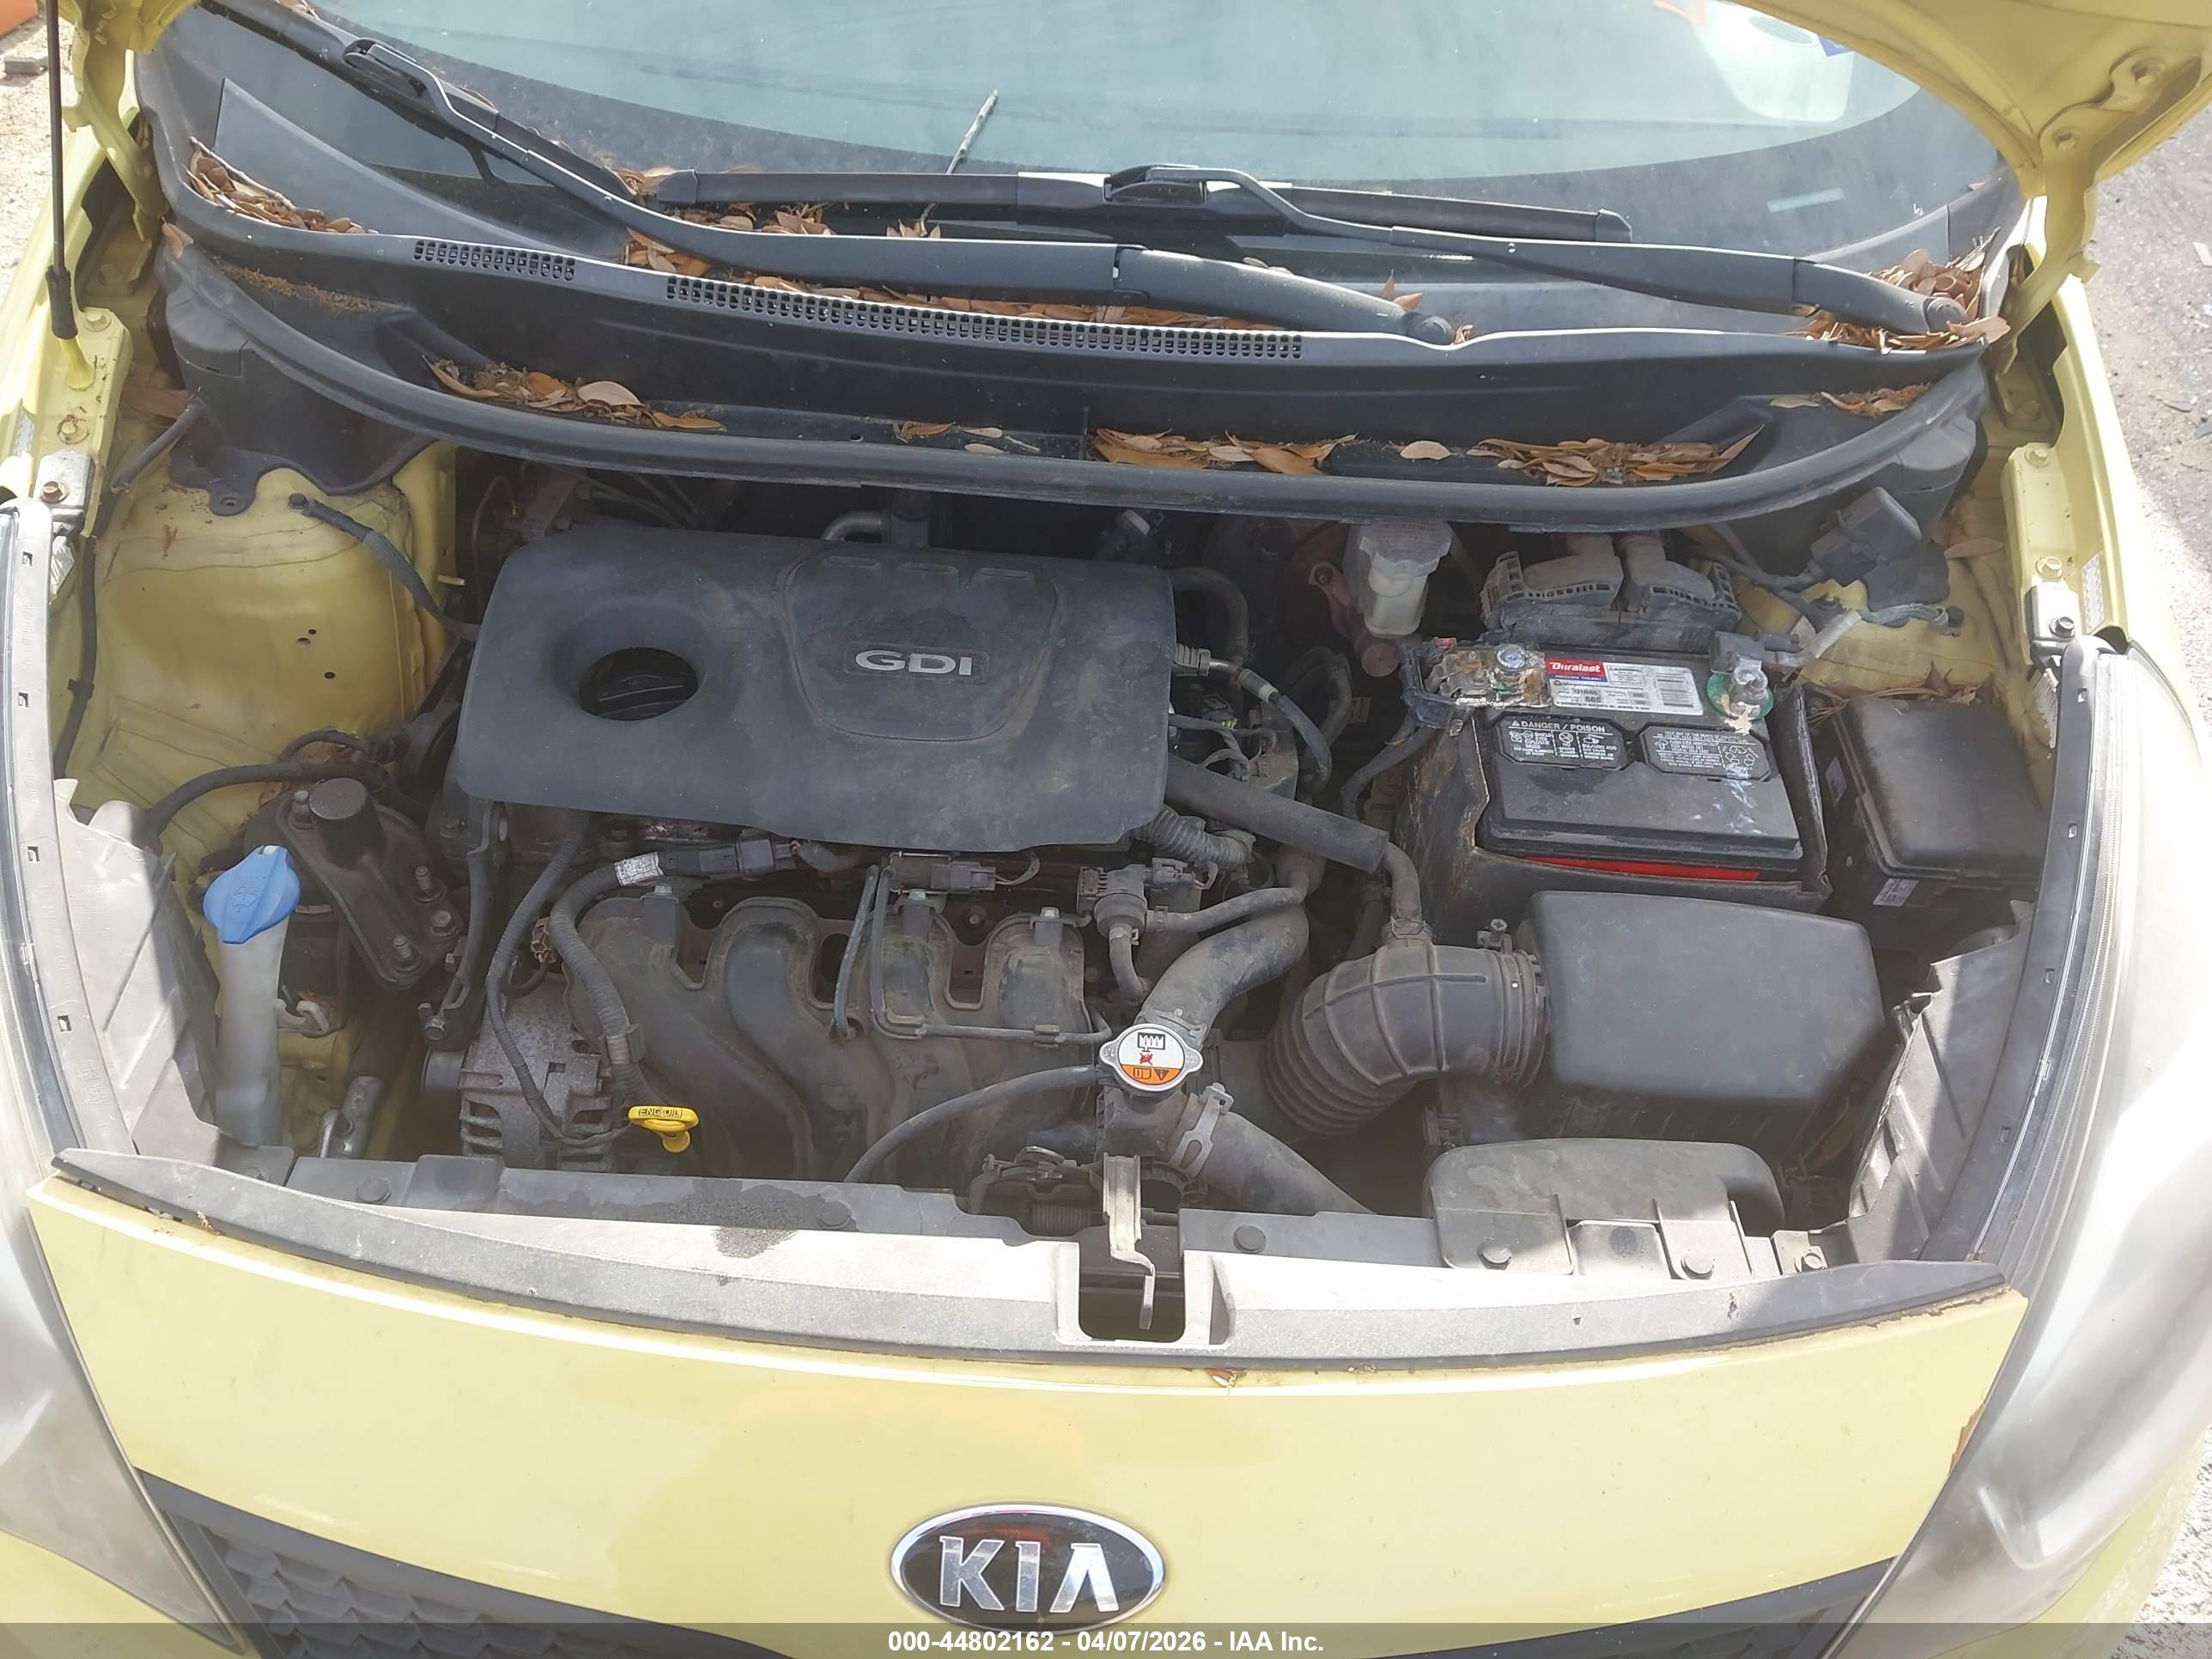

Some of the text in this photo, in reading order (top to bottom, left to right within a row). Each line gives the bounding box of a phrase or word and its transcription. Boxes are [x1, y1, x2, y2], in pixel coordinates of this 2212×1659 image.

[855, 649, 972, 676] GDI
[1549, 661, 1601, 673] Duralast
[1522, 720, 1560, 730] DANGER
[1571, 724, 1605, 733] POISON
[639, 1108, 681, 1117] ENG OIL
[939, 1535, 1119, 1613] KIA
